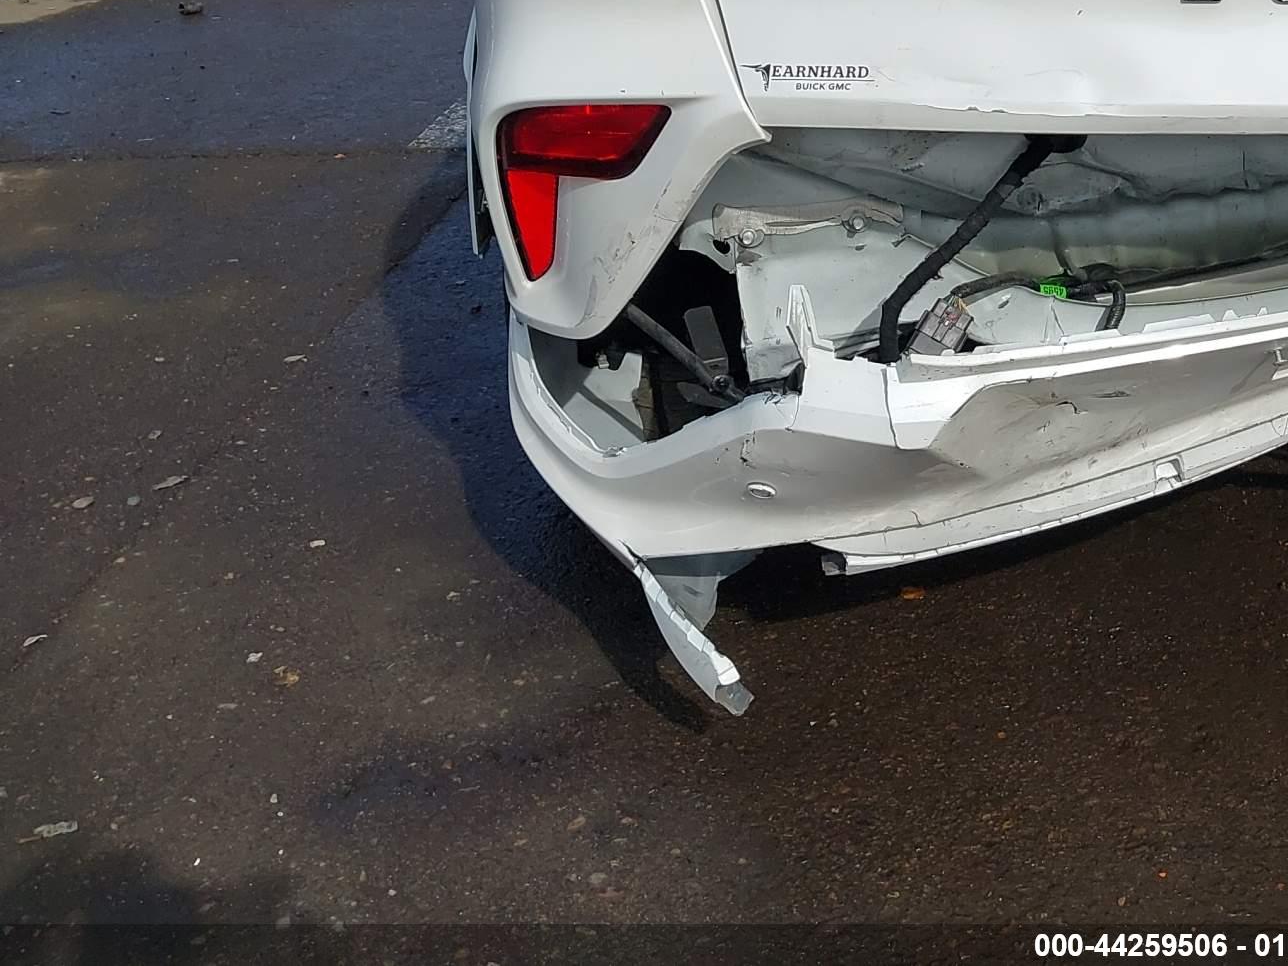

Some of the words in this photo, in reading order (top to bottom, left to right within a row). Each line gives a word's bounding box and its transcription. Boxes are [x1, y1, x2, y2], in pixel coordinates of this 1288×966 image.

[771, 64, 870, 79] EARNHARD
[795, 82, 826, 91] BUICK
[828, 82, 852, 91] GMC
